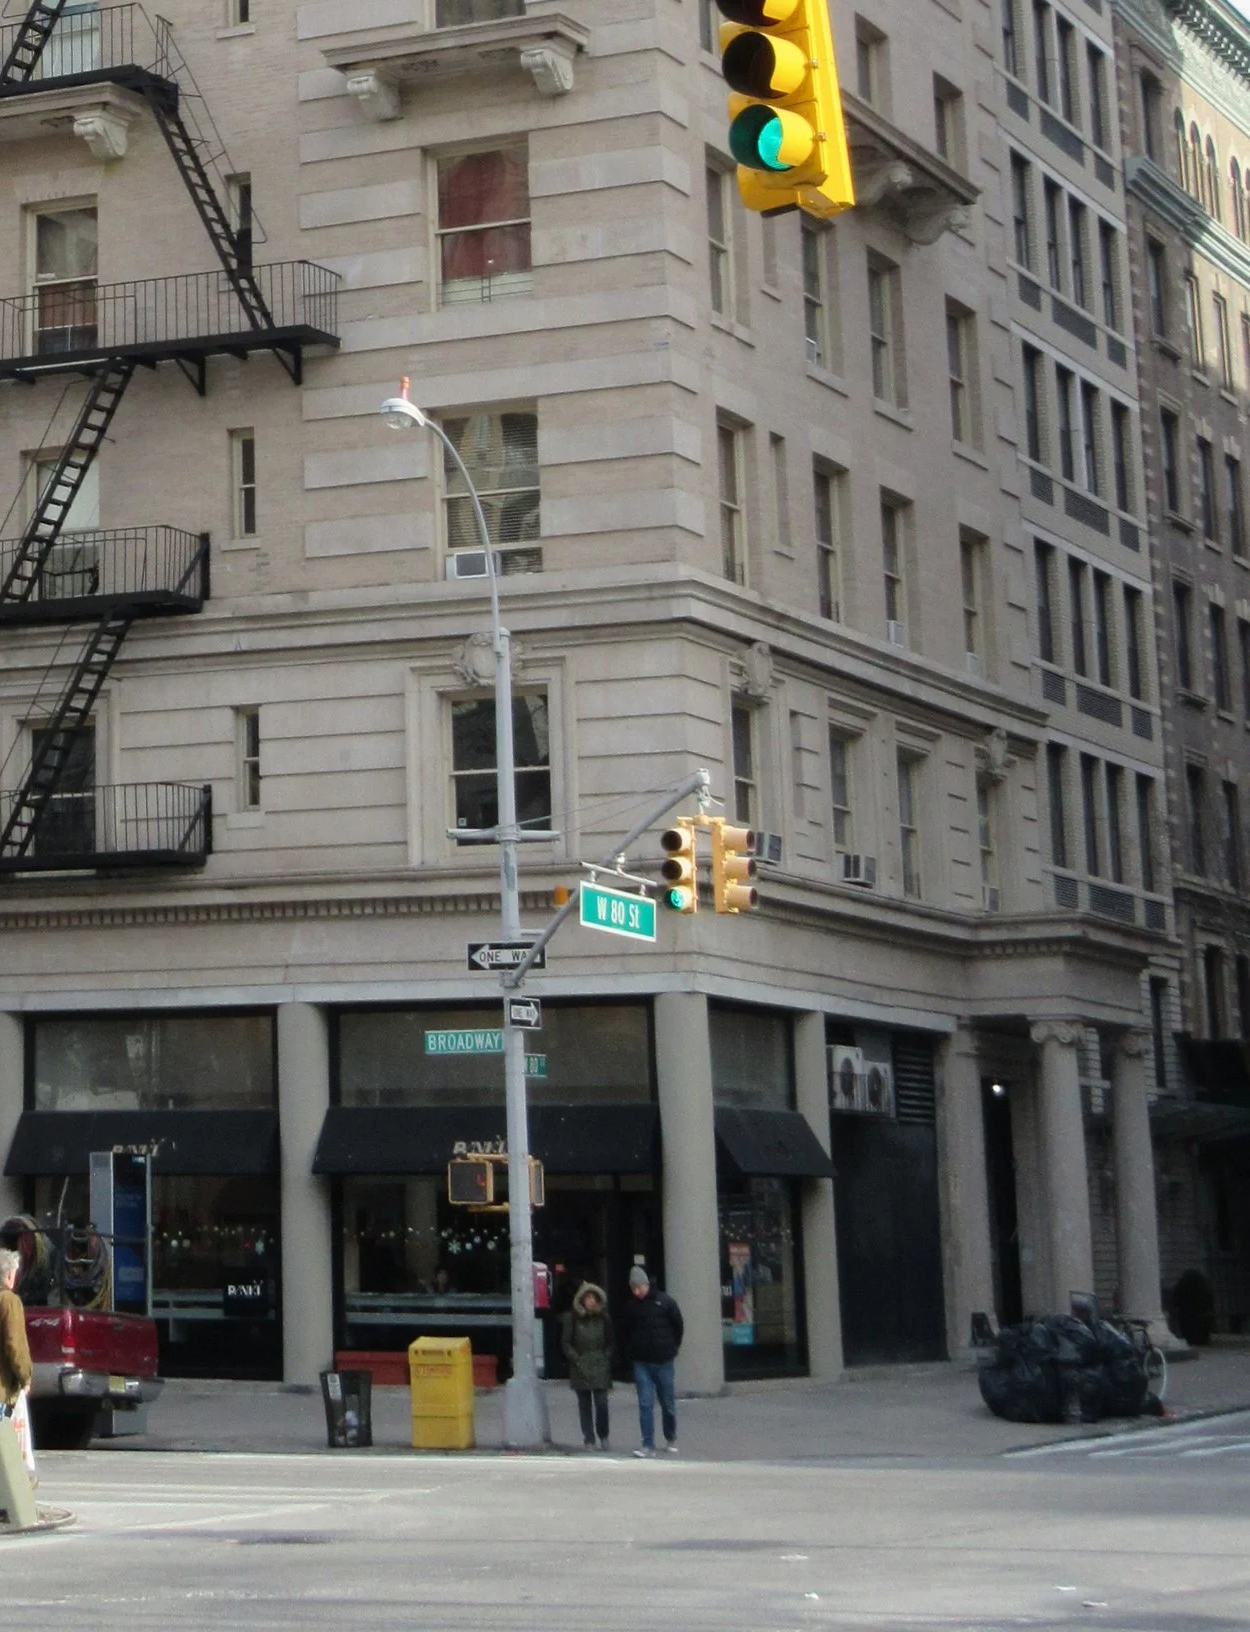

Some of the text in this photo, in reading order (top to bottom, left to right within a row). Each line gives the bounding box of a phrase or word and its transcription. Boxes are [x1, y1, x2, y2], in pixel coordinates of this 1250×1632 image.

[597, 896, 640, 929] W 80 St
[479, 950, 529, 962] ONE WA
[428, 1033, 500, 1050] BROADWAY
